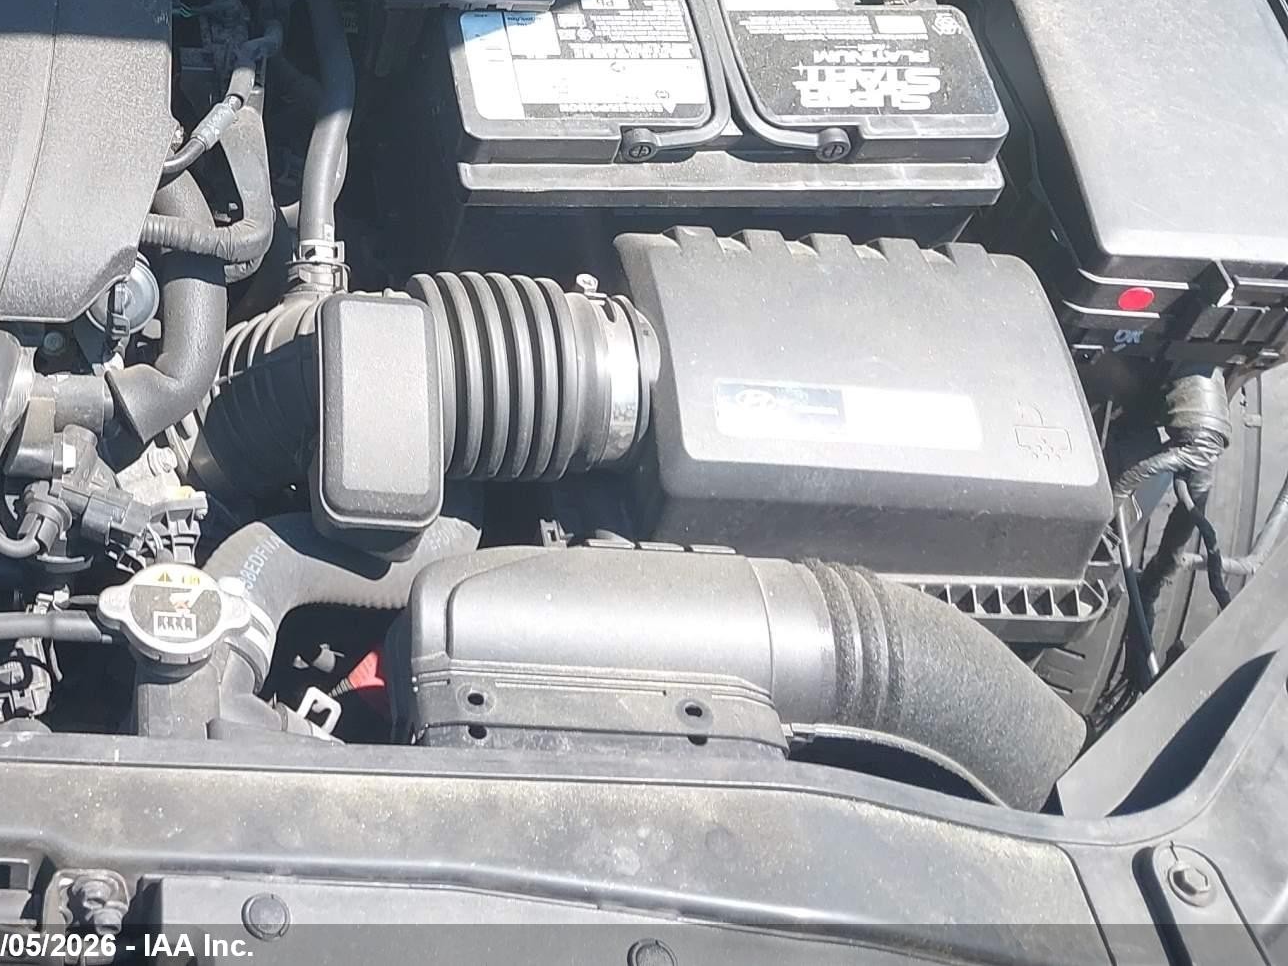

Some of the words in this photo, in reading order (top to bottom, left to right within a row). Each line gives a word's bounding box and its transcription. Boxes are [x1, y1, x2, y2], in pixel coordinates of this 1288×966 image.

[813, 49, 930, 63] PLATINUM
[802, 67, 941, 92] START
[799, 89, 931, 111] SUPER
